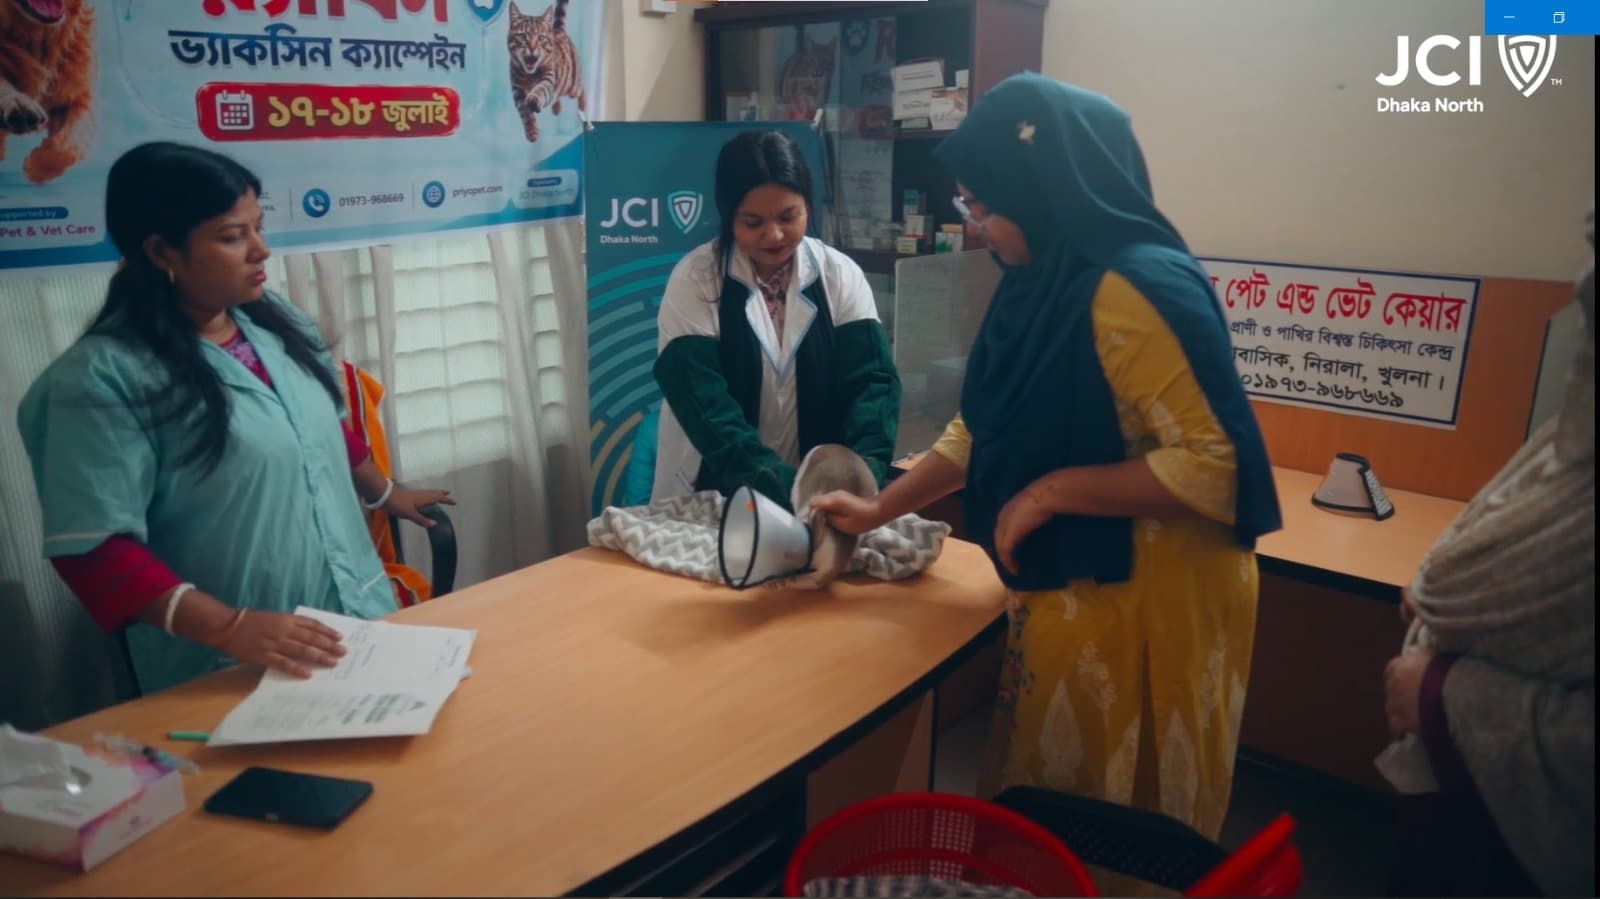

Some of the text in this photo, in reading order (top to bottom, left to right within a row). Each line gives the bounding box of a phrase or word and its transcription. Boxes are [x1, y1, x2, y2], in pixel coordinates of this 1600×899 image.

[168, 23, 467, 70] ভ্যাকসিন ক্যাম্পেইন
[268, 92, 449, 131] ১৭-১৮ জুলাই
[0, 223, 96, 237] Pet & Vet Care
[600, 197, 659, 228] JCI
[600, 234, 659, 244] Dhaka North
[1225, 269, 1468, 333] পেট এন্ড ভেট কেয়ার
[1262, 325, 1273, 337] ও
[1276, 323, 1314, 343] পাখির
[1359, 331, 1413, 356] চিকিৎসা
[1417, 343, 1456, 362] কেন্দ্র
[1232, 345, 1294, 373] বাসিক,
[1302, 351, 1368, 384] নিরালা,
